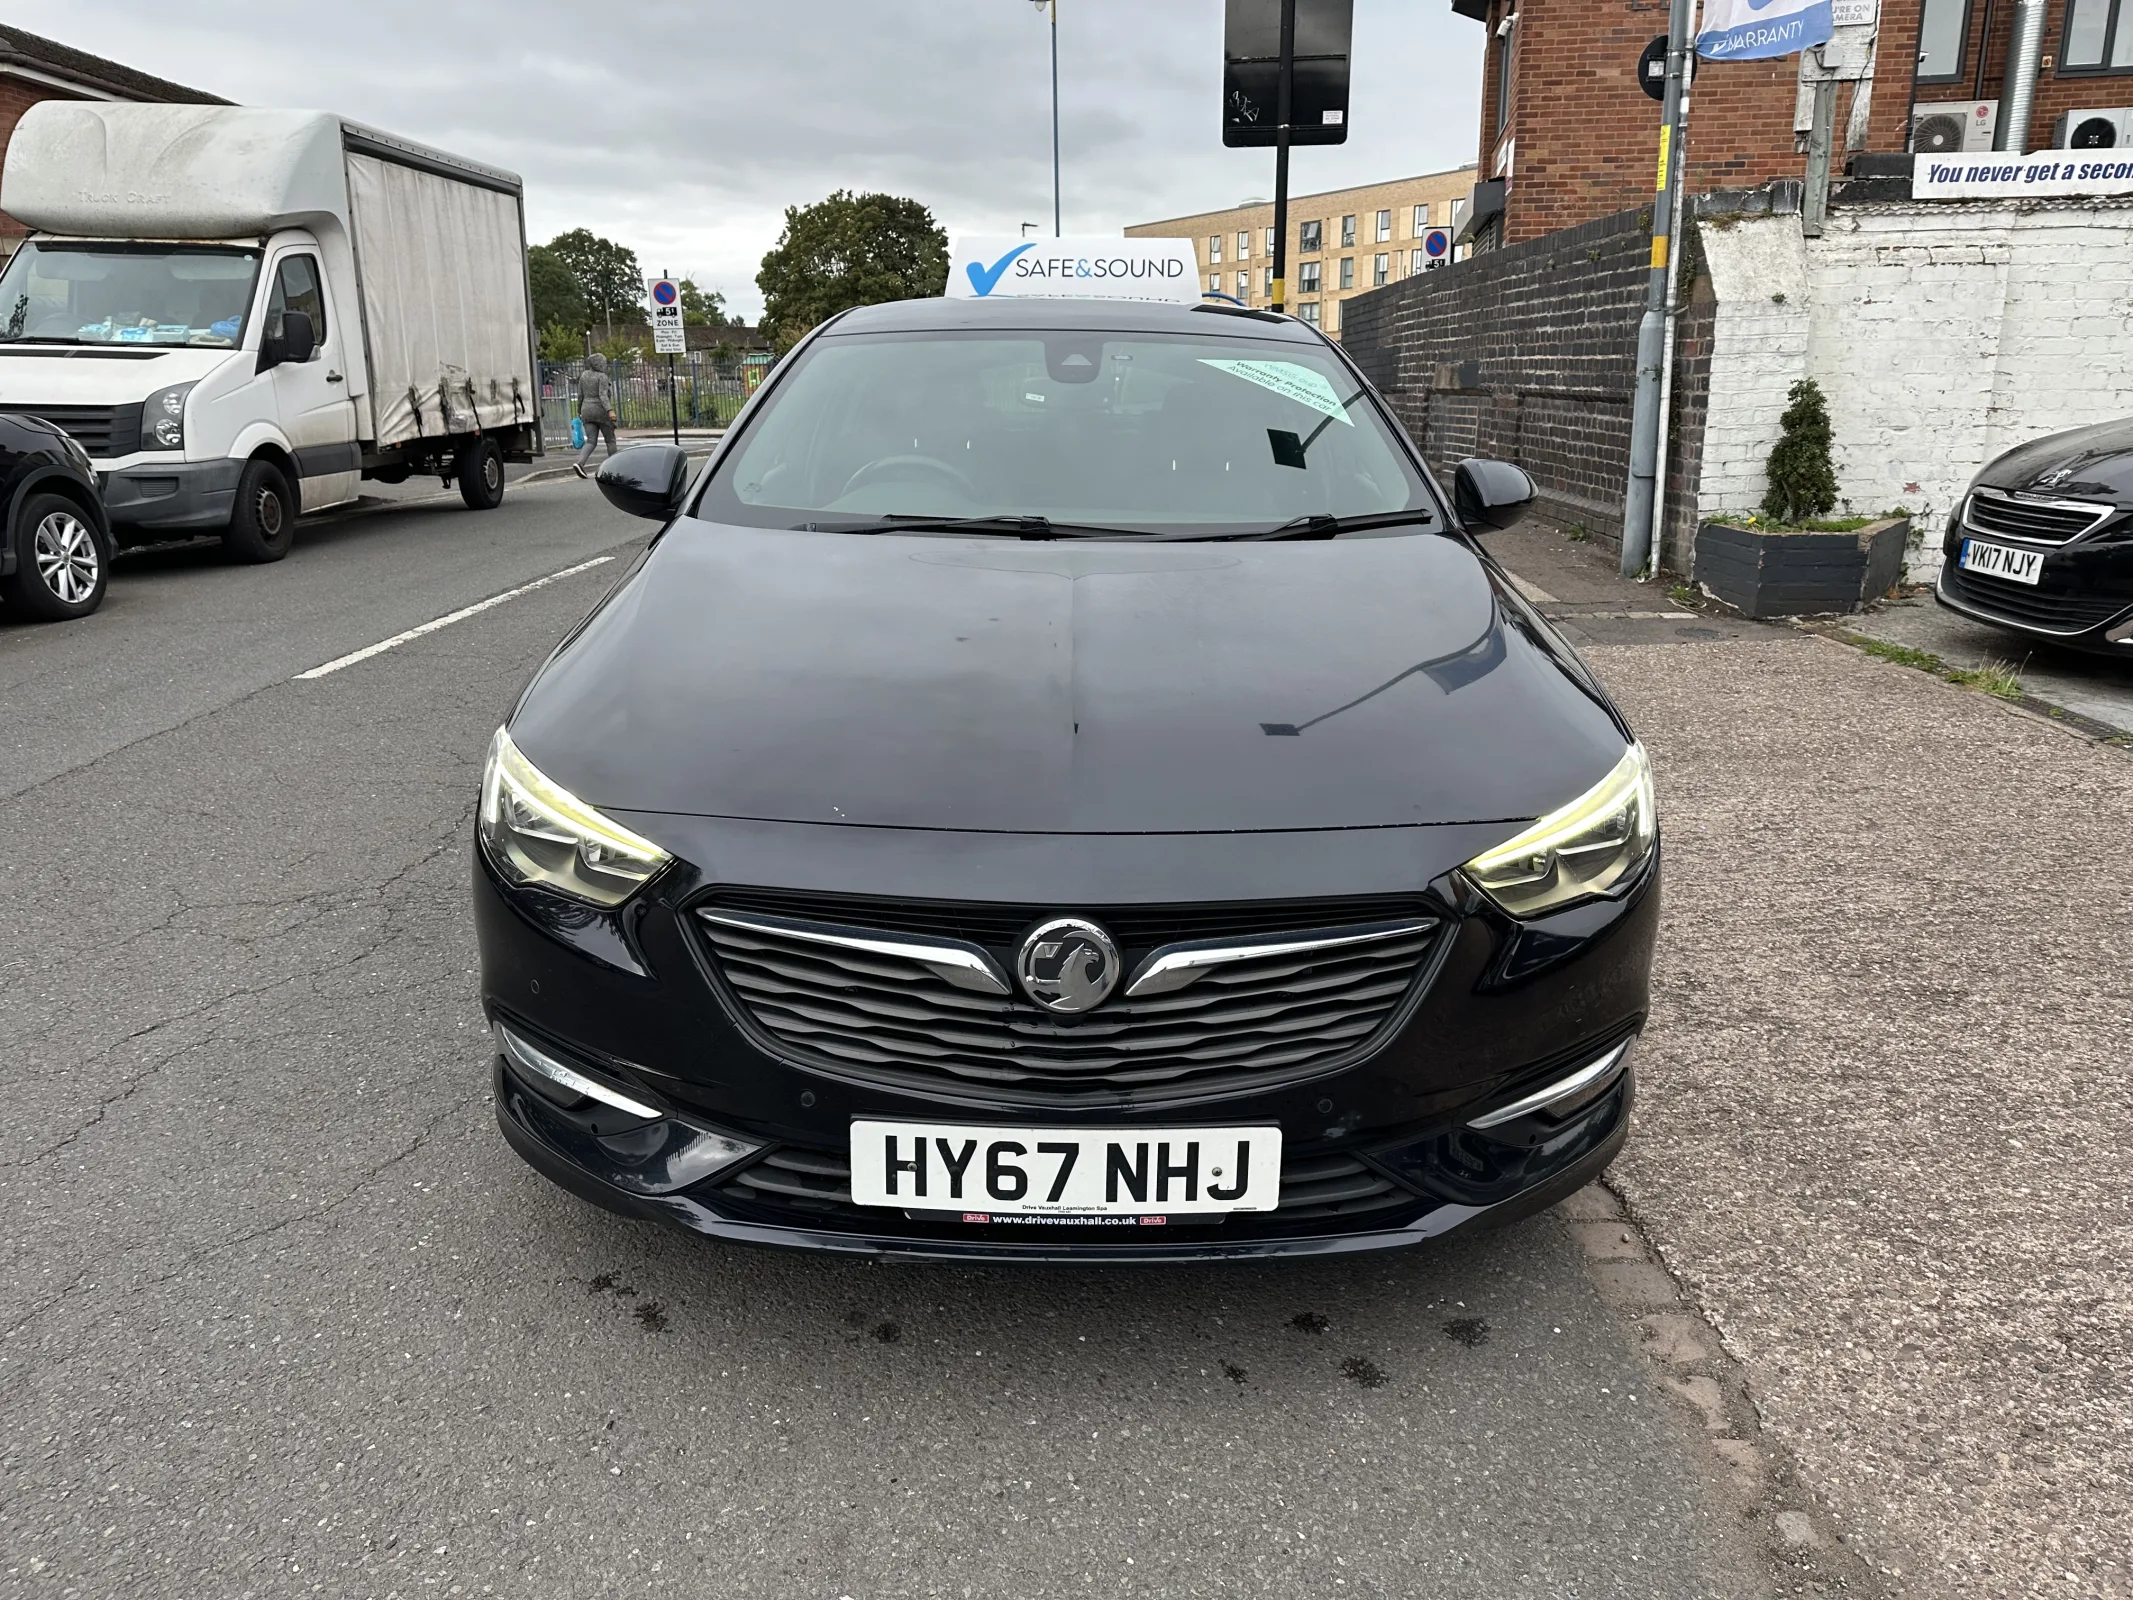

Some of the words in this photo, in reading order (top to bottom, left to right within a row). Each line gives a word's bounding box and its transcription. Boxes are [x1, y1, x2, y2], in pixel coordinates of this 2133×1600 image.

[1854, 4, 1871, 12] ON
[1975, 119, 1986, 127] LG
[1928, 163, 1963, 184] You
[1965, 165, 2024, 183] never
[2024, 162, 2061, 183] get
[2061, 163, 2076, 180] a
[1015, 258, 1184, 278] SAFE&SOUND
[657, 319, 679, 327] ZONE
[1227, 365, 1275, 387] Available
[1276, 384, 1292, 395] on
[1293, 391, 1311, 403] this
[1313, 401, 1332, 411] car
[1237, 361, 1283, 383] Warranty
[1284, 380, 1337, 406] Protection
[1972, 543, 2002, 570] VK17
[2002, 550, 2037, 577] NJY
[885, 1135, 1080, 1203] HY67
[1106, 1140, 1250, 1203] NHJ
[966, 1214, 985, 1222] Drive
[993, 1215, 1137, 1225] www.drivevauxhall.co.uk
[1143, 1216, 1163, 1224] Drive
